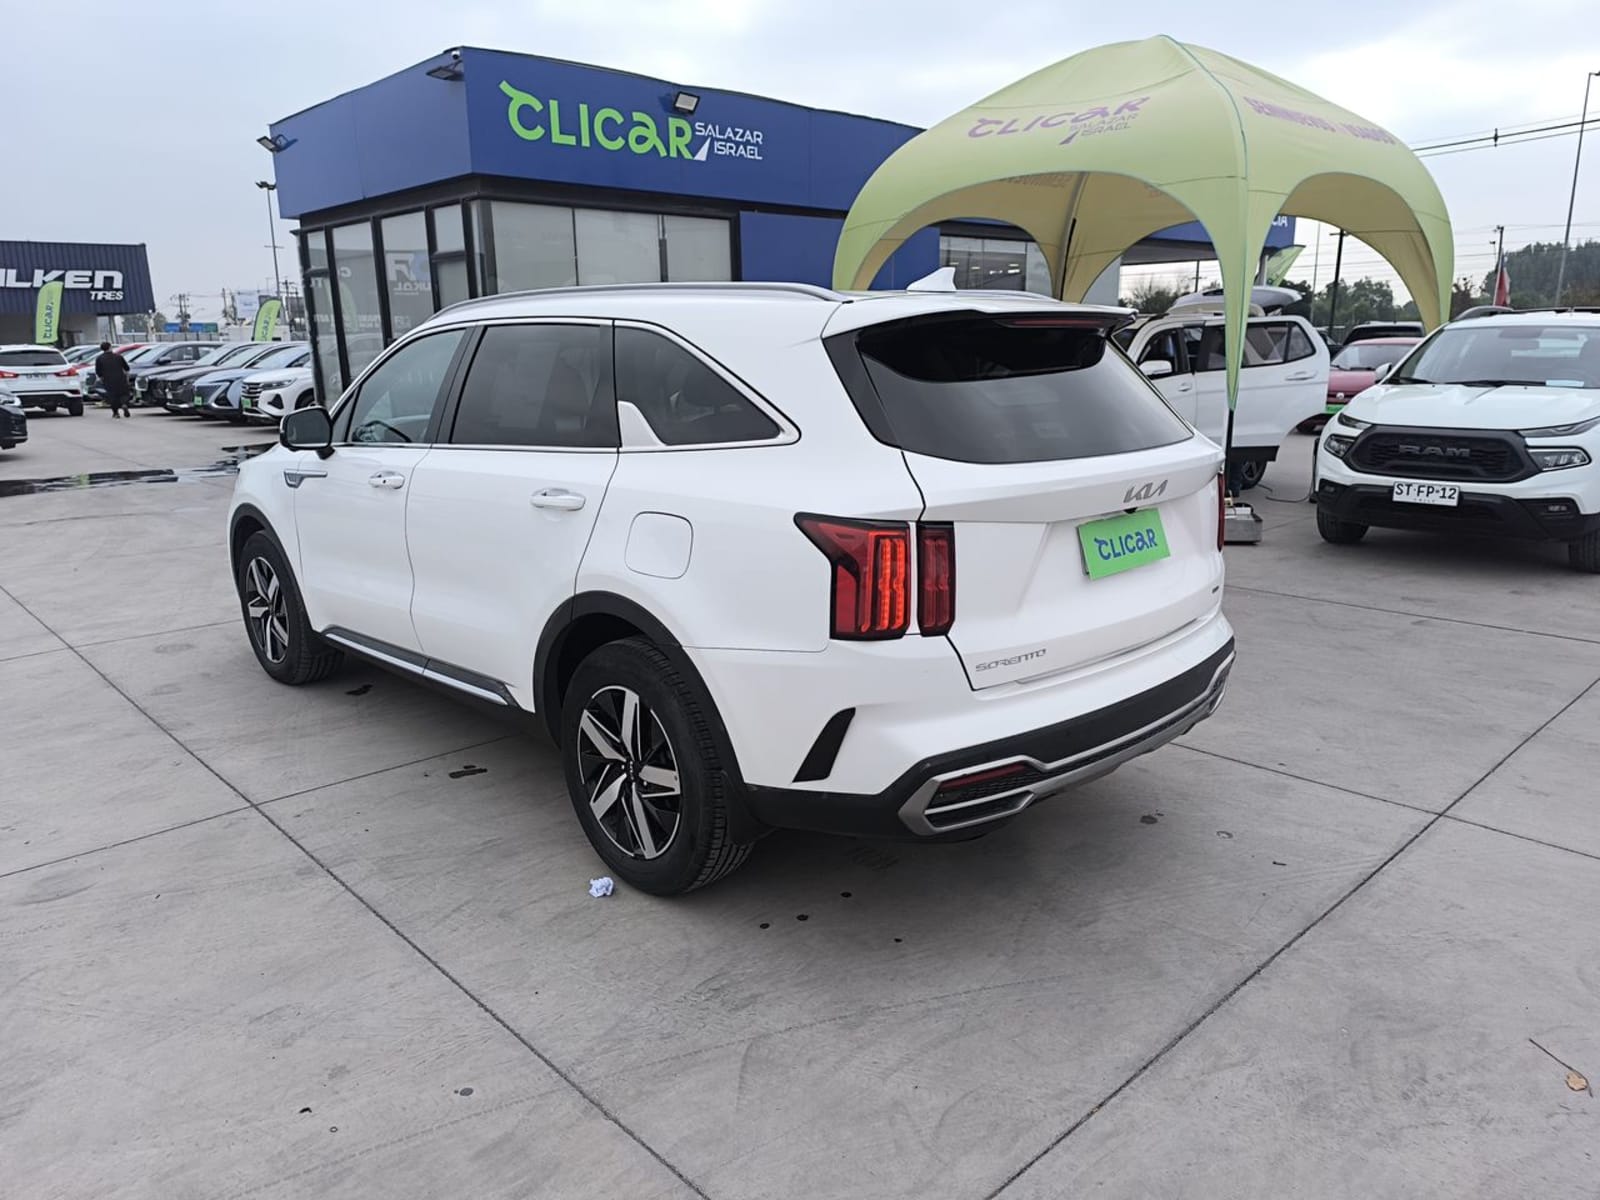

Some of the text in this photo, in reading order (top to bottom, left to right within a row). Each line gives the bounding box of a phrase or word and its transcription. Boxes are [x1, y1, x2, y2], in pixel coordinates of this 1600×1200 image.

[695, 122, 763, 145] SALAZAR
[713, 141, 763, 161] ISRAEL
[0, 268, 123, 289] LKEN
[90, 290, 124, 301] TIRES
[1399, 444, 1470, 457] RAM
[1123, 479, 1168, 503] KIA
[975, 648, 1047, 672] SORENTO
